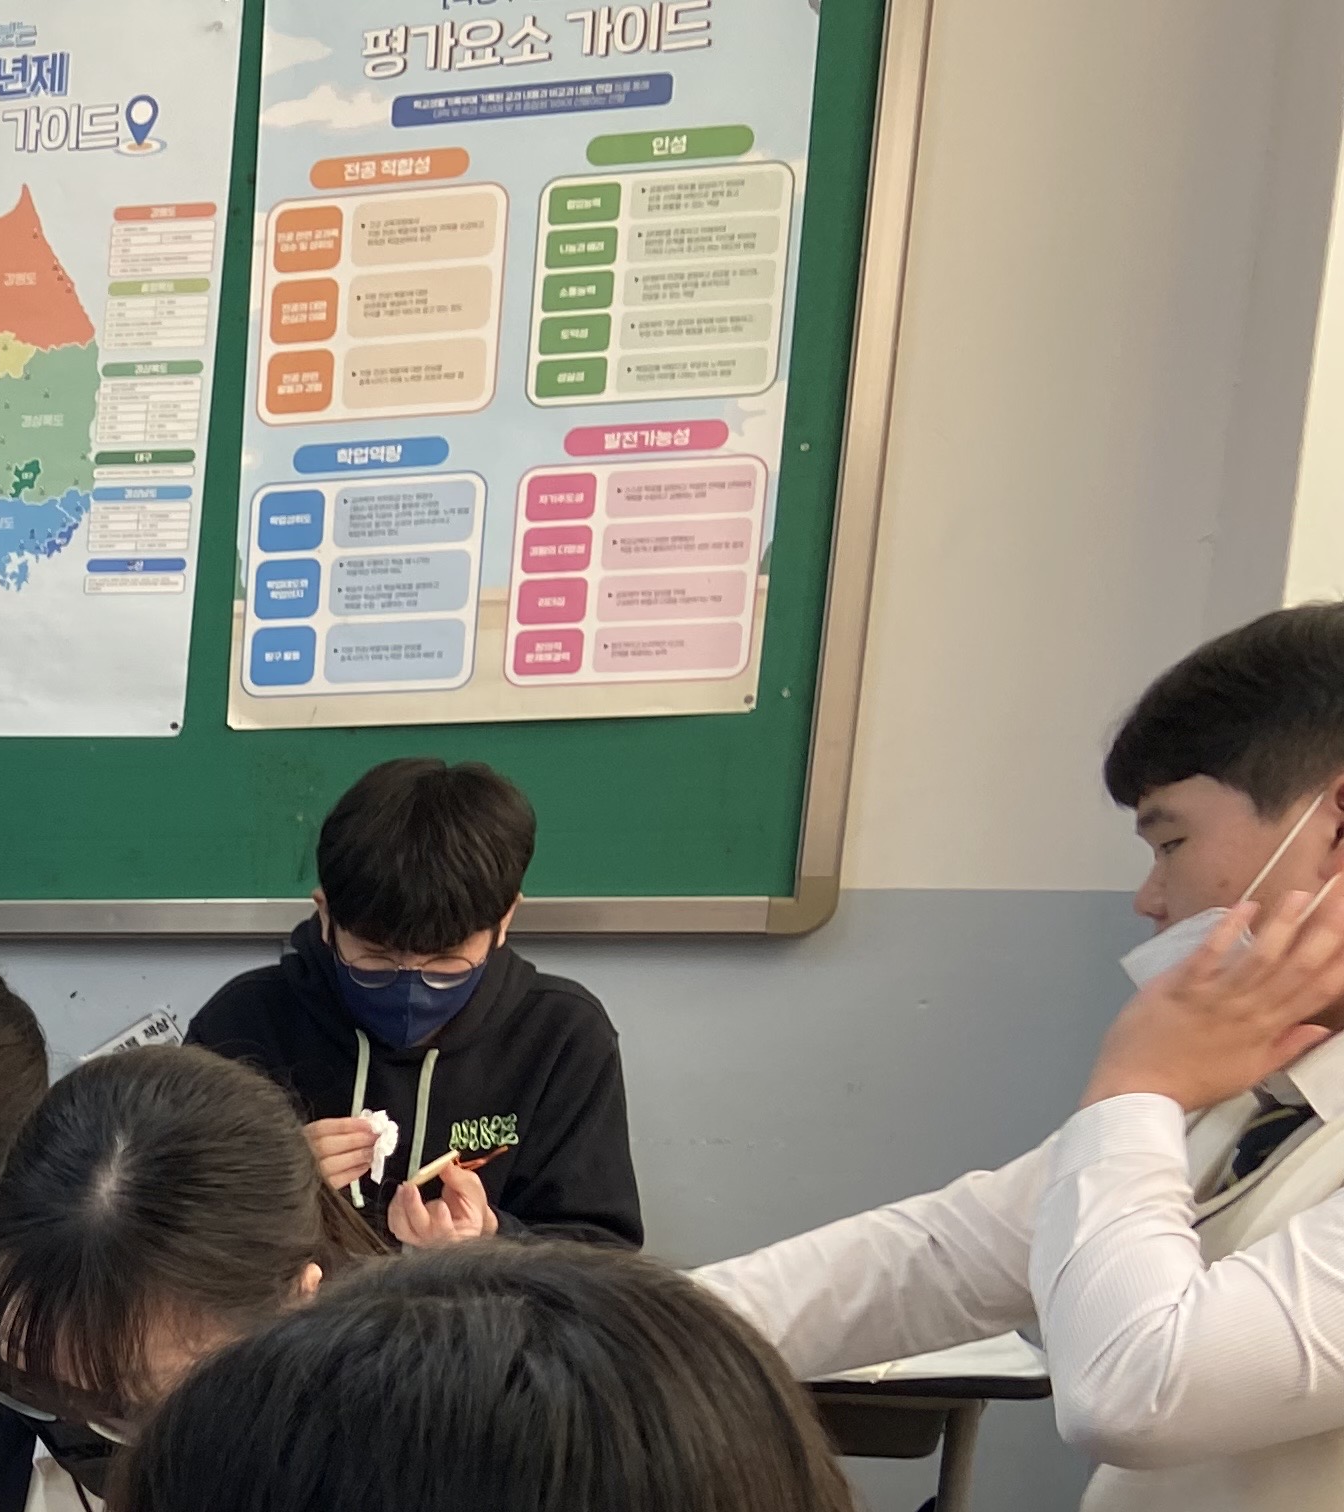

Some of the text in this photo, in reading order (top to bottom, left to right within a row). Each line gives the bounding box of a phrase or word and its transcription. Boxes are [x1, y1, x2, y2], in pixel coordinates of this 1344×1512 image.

[362, 0, 713, 80] 평가요소 가이드
[2, 103, 120, 154] 가이드
[652, 135, 687, 156] 인성
[344, 161, 376, 182] 전공
